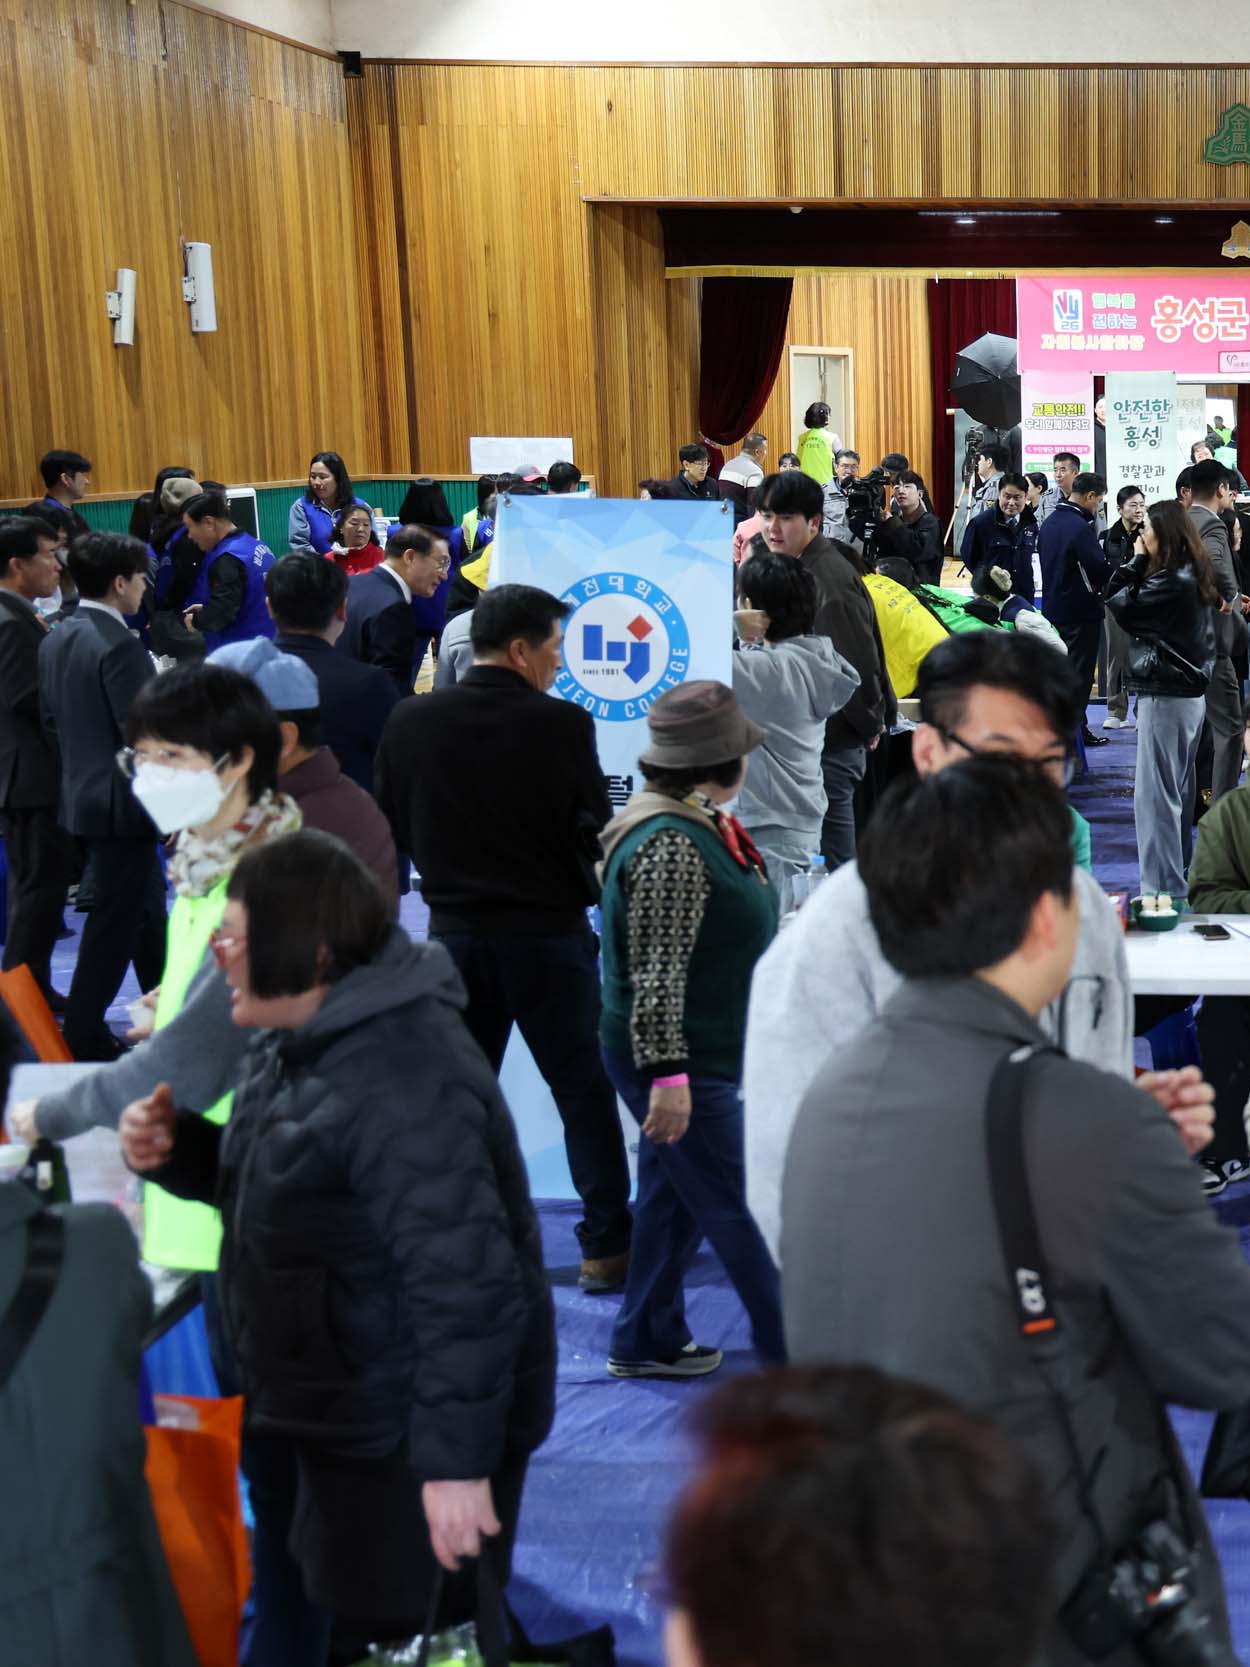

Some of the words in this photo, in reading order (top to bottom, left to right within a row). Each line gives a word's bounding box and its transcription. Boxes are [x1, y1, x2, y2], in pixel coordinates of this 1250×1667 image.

[1092, 313, 1136, 329] 전하는
[1152, 297, 1249, 342] 홍성군
[1032, 403, 1086, 417] 교통안전!!
[1113, 399, 1172, 421] 안전한
[1025, 419, 1043, 430] 우리
[1063, 419, 1090, 430] 지켜요
[1124, 426, 1161, 449] 홍성
[1119, 464, 1166, 479] 경찰관과
[556, 672, 610, 718] EJEON
